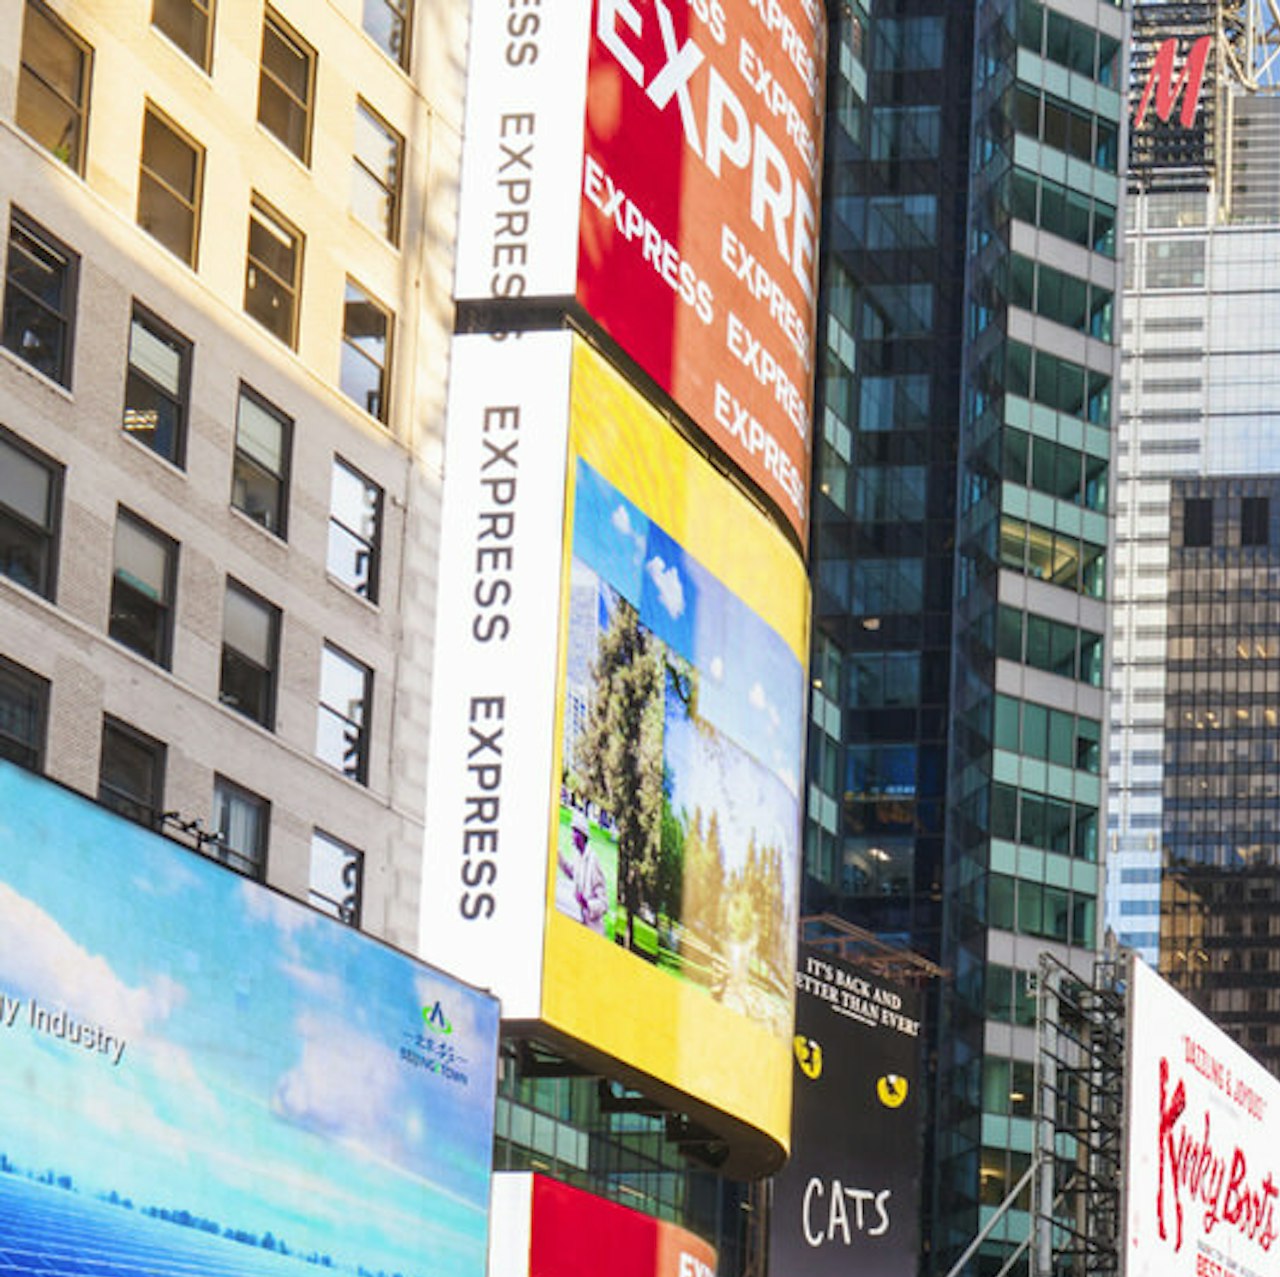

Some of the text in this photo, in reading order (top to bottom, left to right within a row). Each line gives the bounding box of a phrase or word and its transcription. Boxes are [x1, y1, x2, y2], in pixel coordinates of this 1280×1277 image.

[584, 154, 714, 323] EXPRESS
[472, 405, 521, 644] EXPRESS
[461, 695, 506, 921] EXPRESS
[0, 993, 127, 1065] y Industry
[807, 956, 902, 1010] IT'S BACK AND
[841, 989, 880, 1020] THAN
[802, 1177, 892, 1246] CATS
[1157, 1055, 1279, 1254] Kinky Boots
